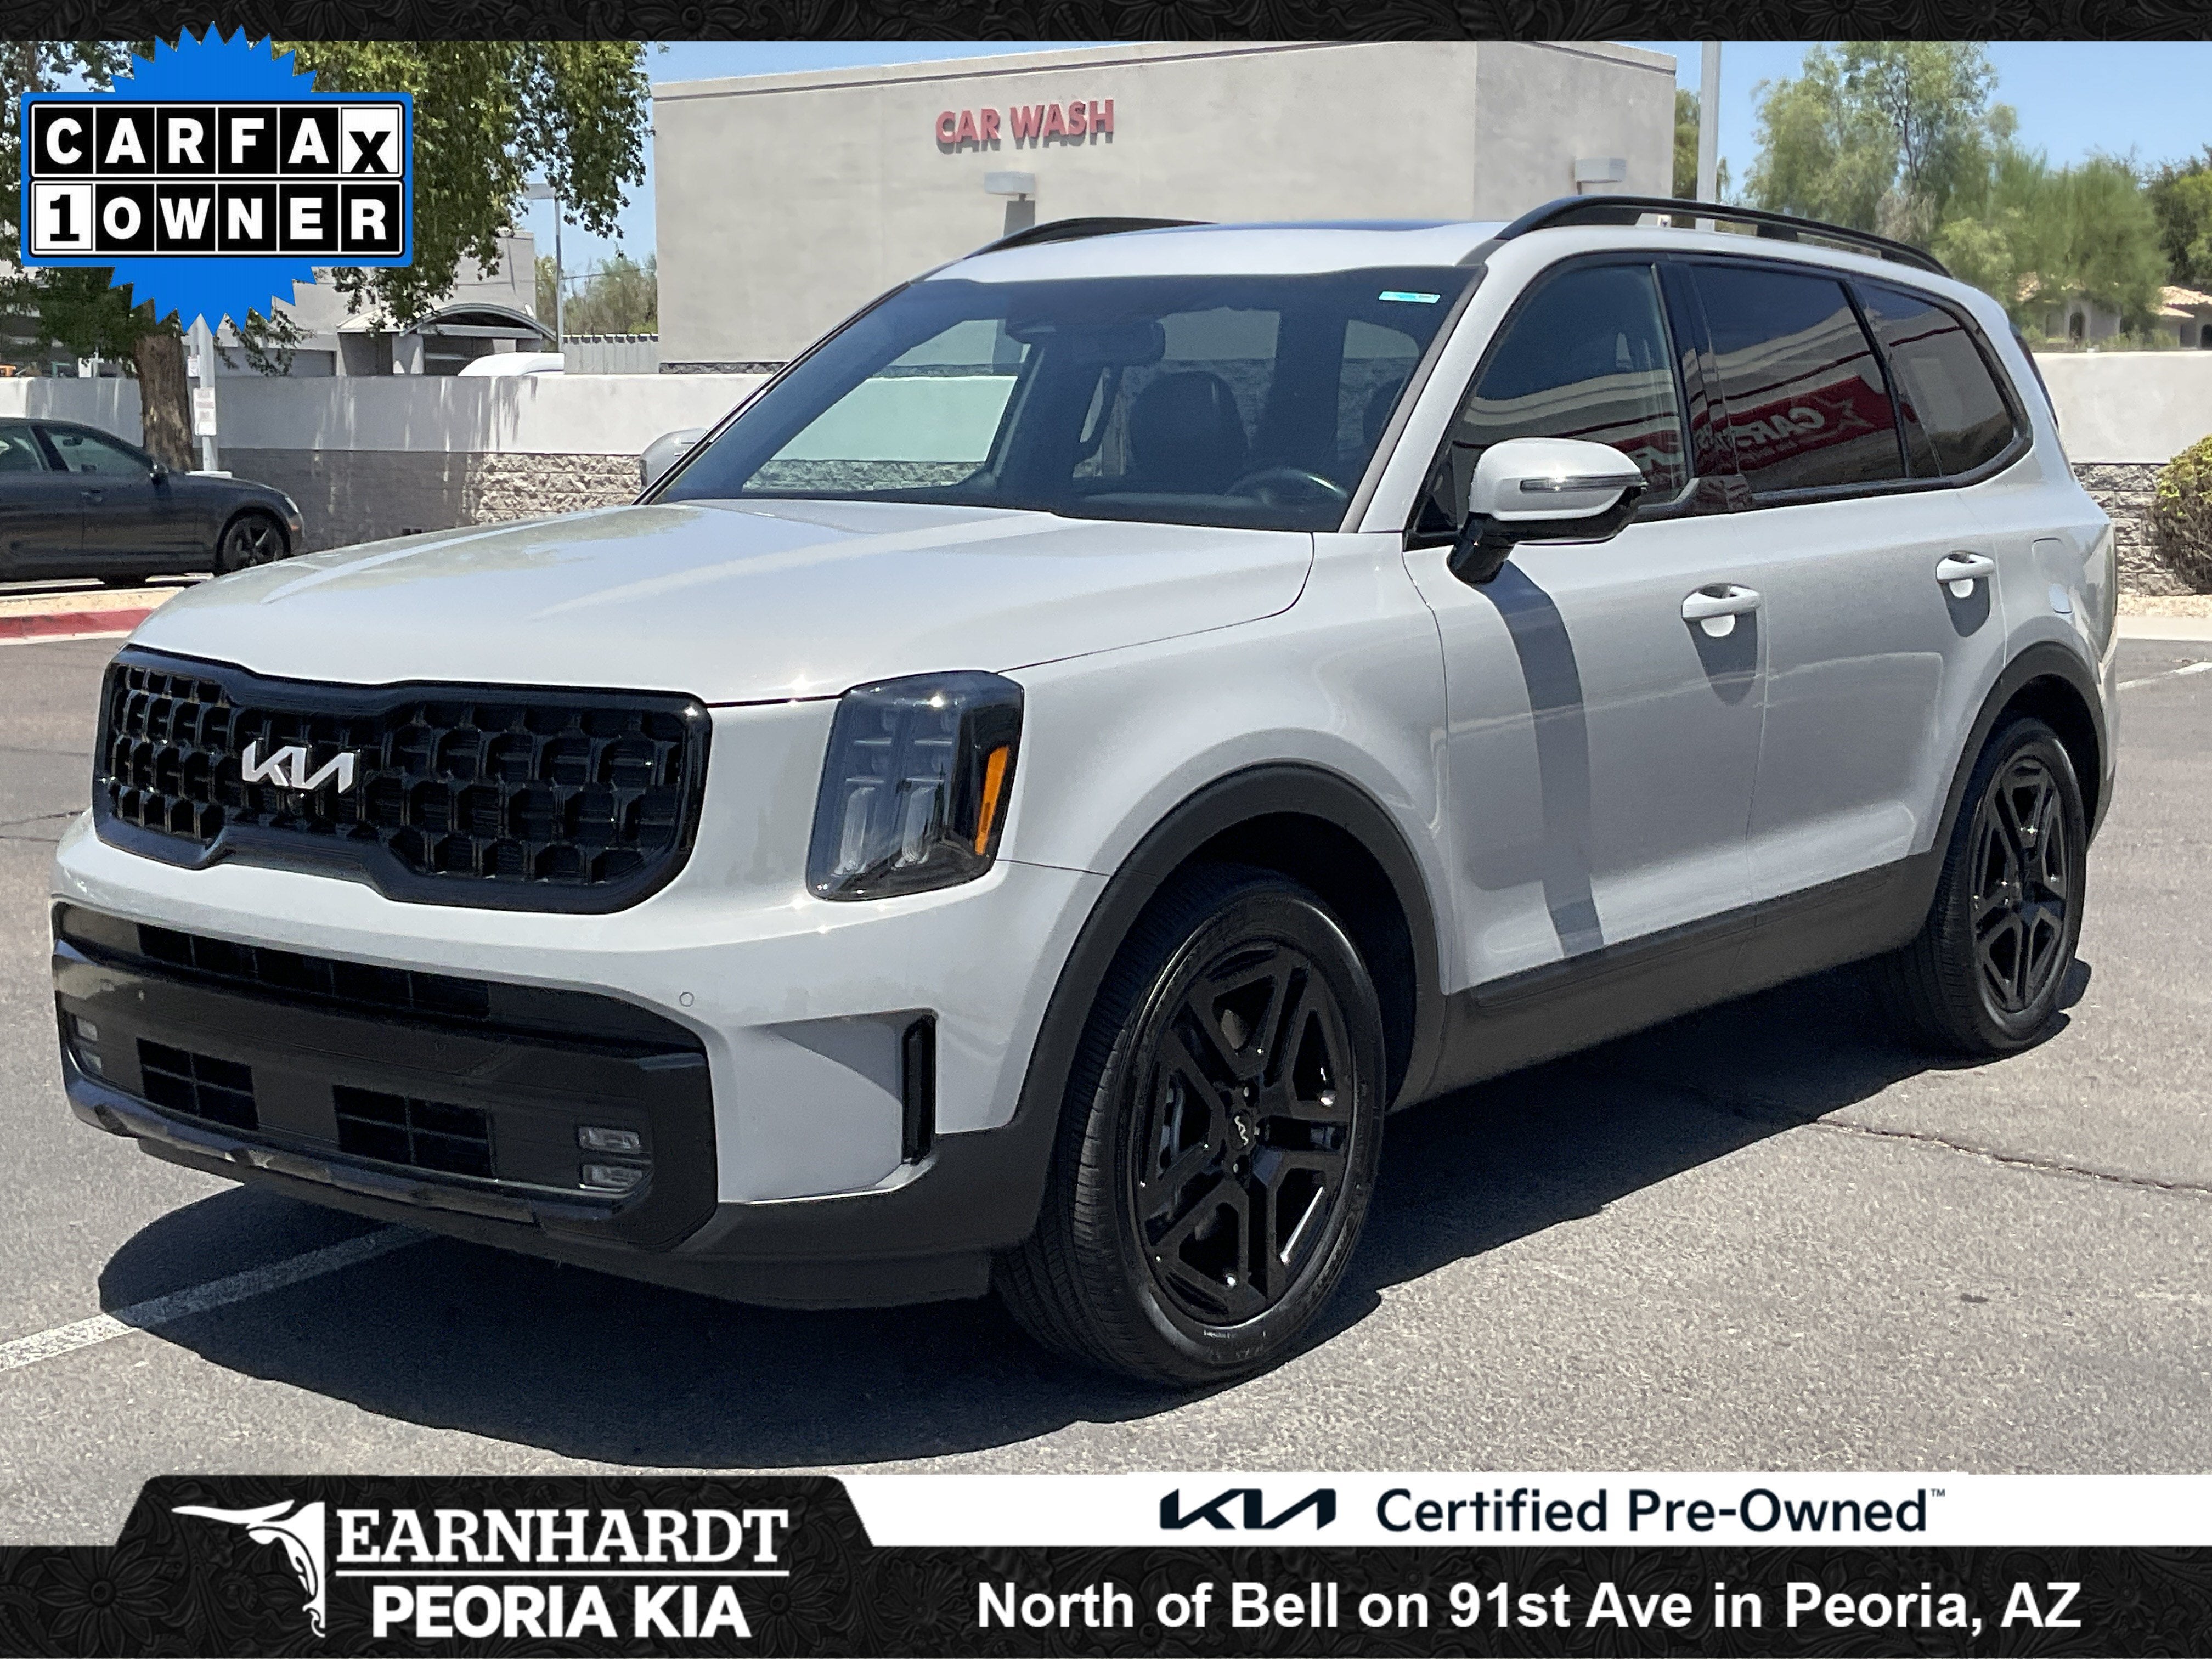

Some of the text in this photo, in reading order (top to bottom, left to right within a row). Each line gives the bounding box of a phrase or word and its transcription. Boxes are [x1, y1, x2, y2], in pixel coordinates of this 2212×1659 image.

[936, 99, 1114, 144] CAR WASH
[241, 740, 357, 794] KIA
